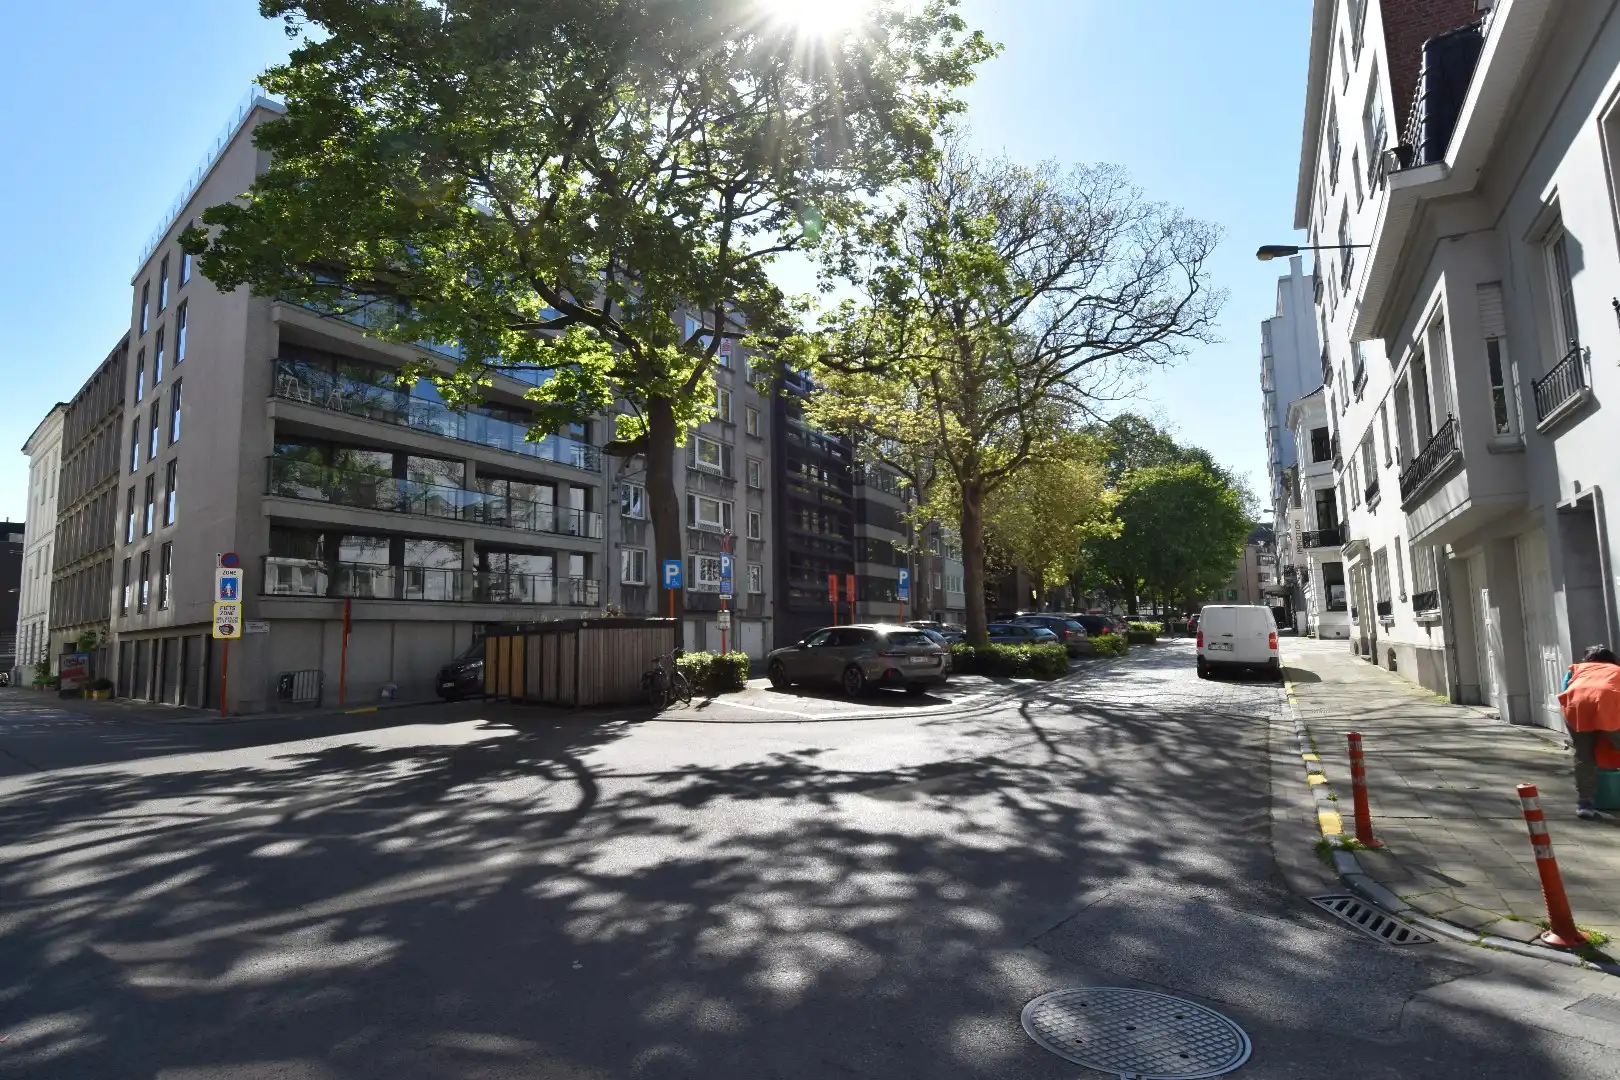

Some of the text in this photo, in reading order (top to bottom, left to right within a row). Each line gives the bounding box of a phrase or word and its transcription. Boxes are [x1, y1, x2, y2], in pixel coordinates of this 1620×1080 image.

[1295, 519, 1303, 554] IMMOTION
[722, 556, 730, 573] P
[665, 564, 679, 584] P
[899, 570, 908, 585] P
